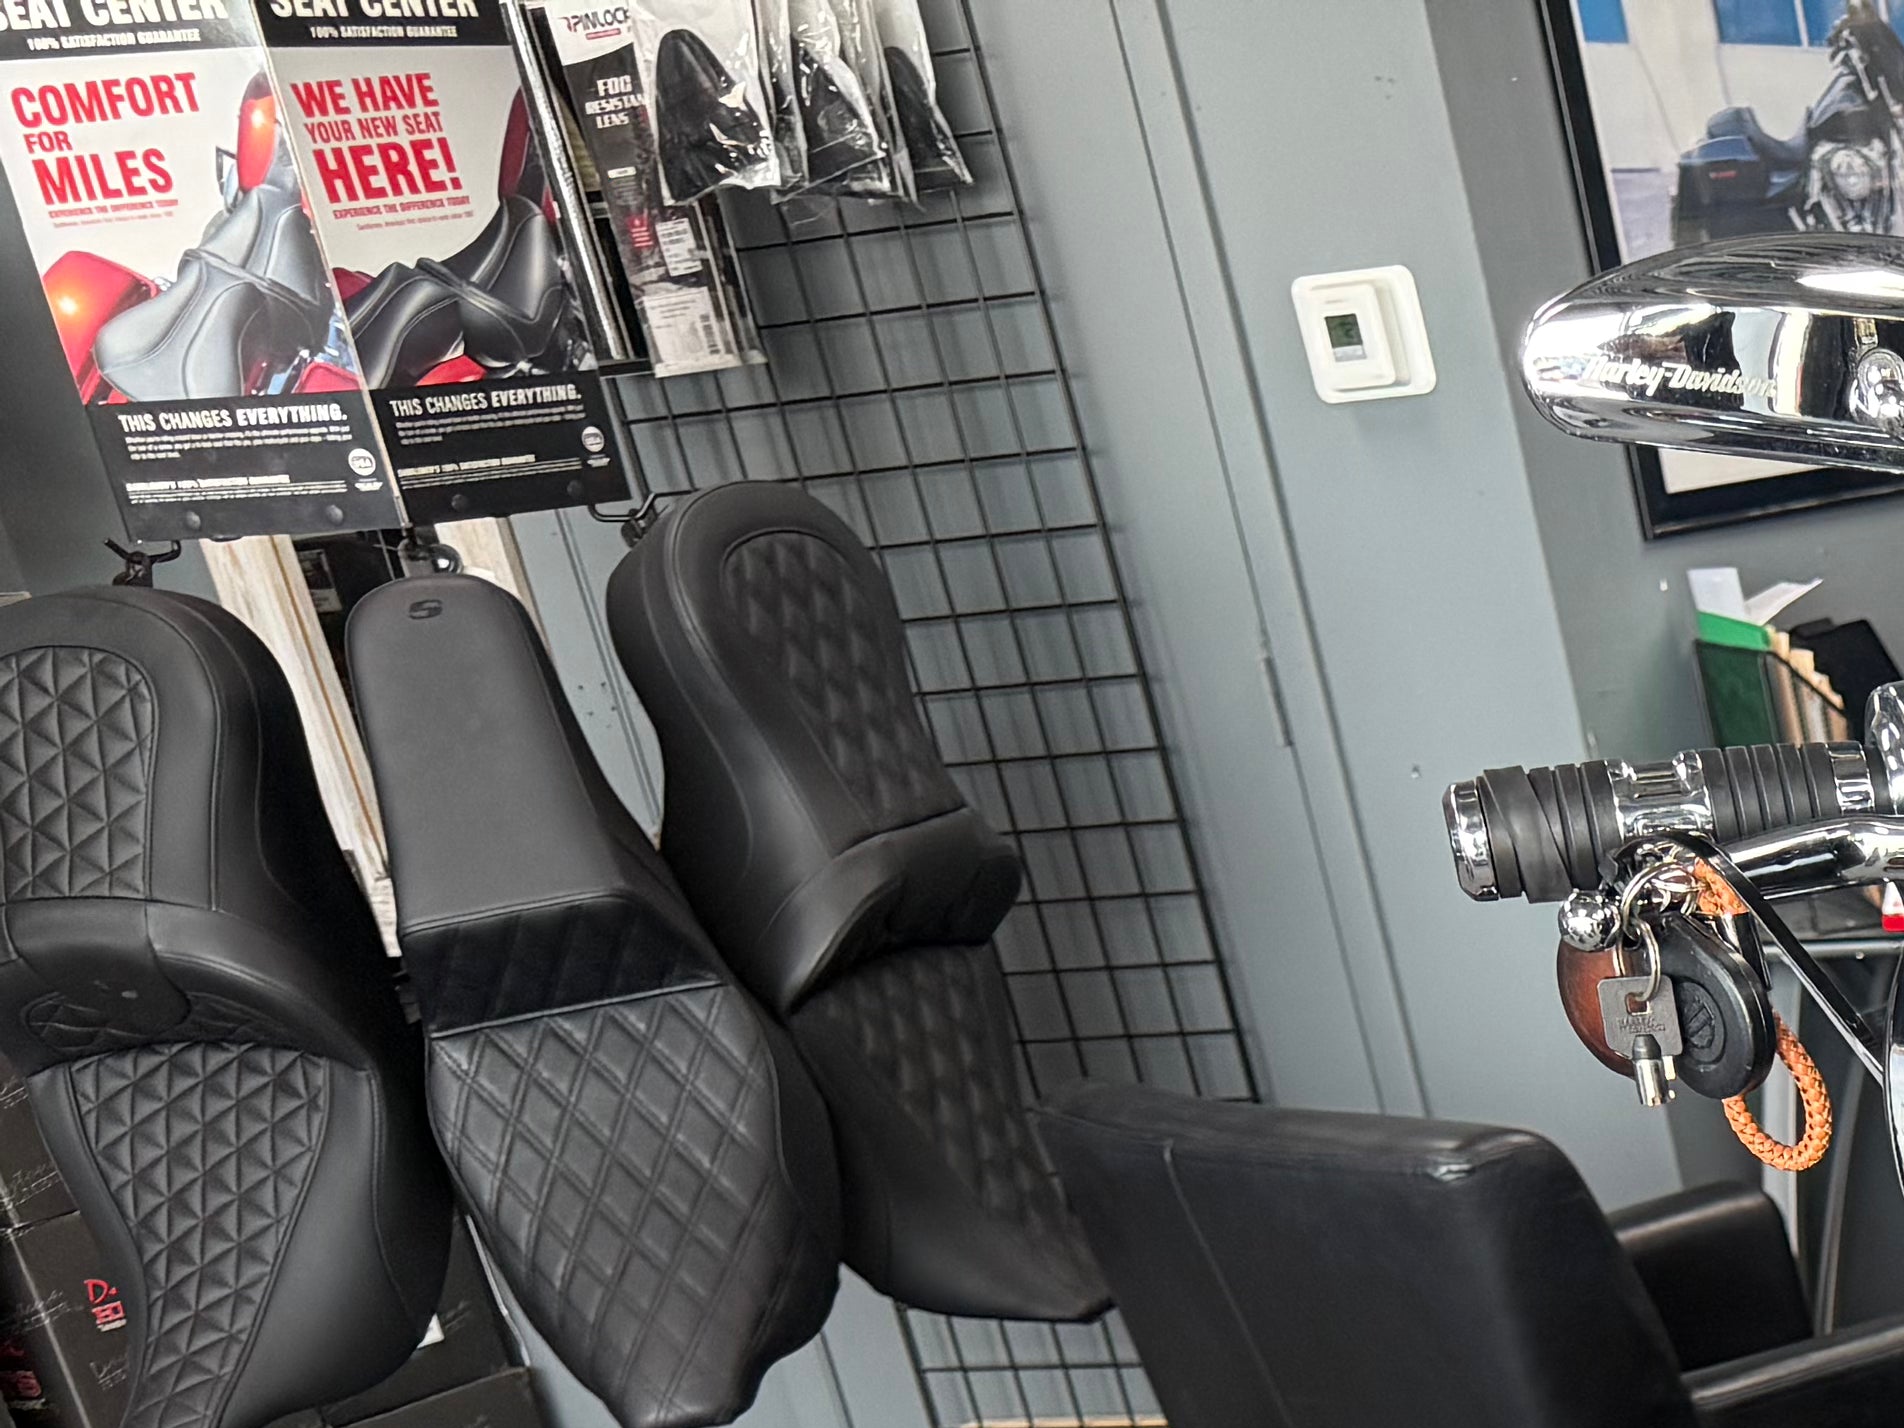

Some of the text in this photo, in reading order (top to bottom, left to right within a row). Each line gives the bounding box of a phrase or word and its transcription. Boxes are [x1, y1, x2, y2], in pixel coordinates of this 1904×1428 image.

[137, 28, 201, 45] GUARANTEE
[11, 72, 199, 128] COMFORT
[290, 72, 440, 118] WE HAVE
[304, 111, 444, 144] YOUR NEW SEAT
[596, 112, 630, 129] LENS
[24, 131, 72, 154] FOR
[32, 148, 173, 206] MILES
[312, 136, 463, 204] HERE!
[1583, 354, 1778, 398] Harley-Davidson
[390, 383, 582, 417] THIS CHANGES EVERYTHING.
[118, 403, 348, 432] THIS CHANGES EVERYTHING.
